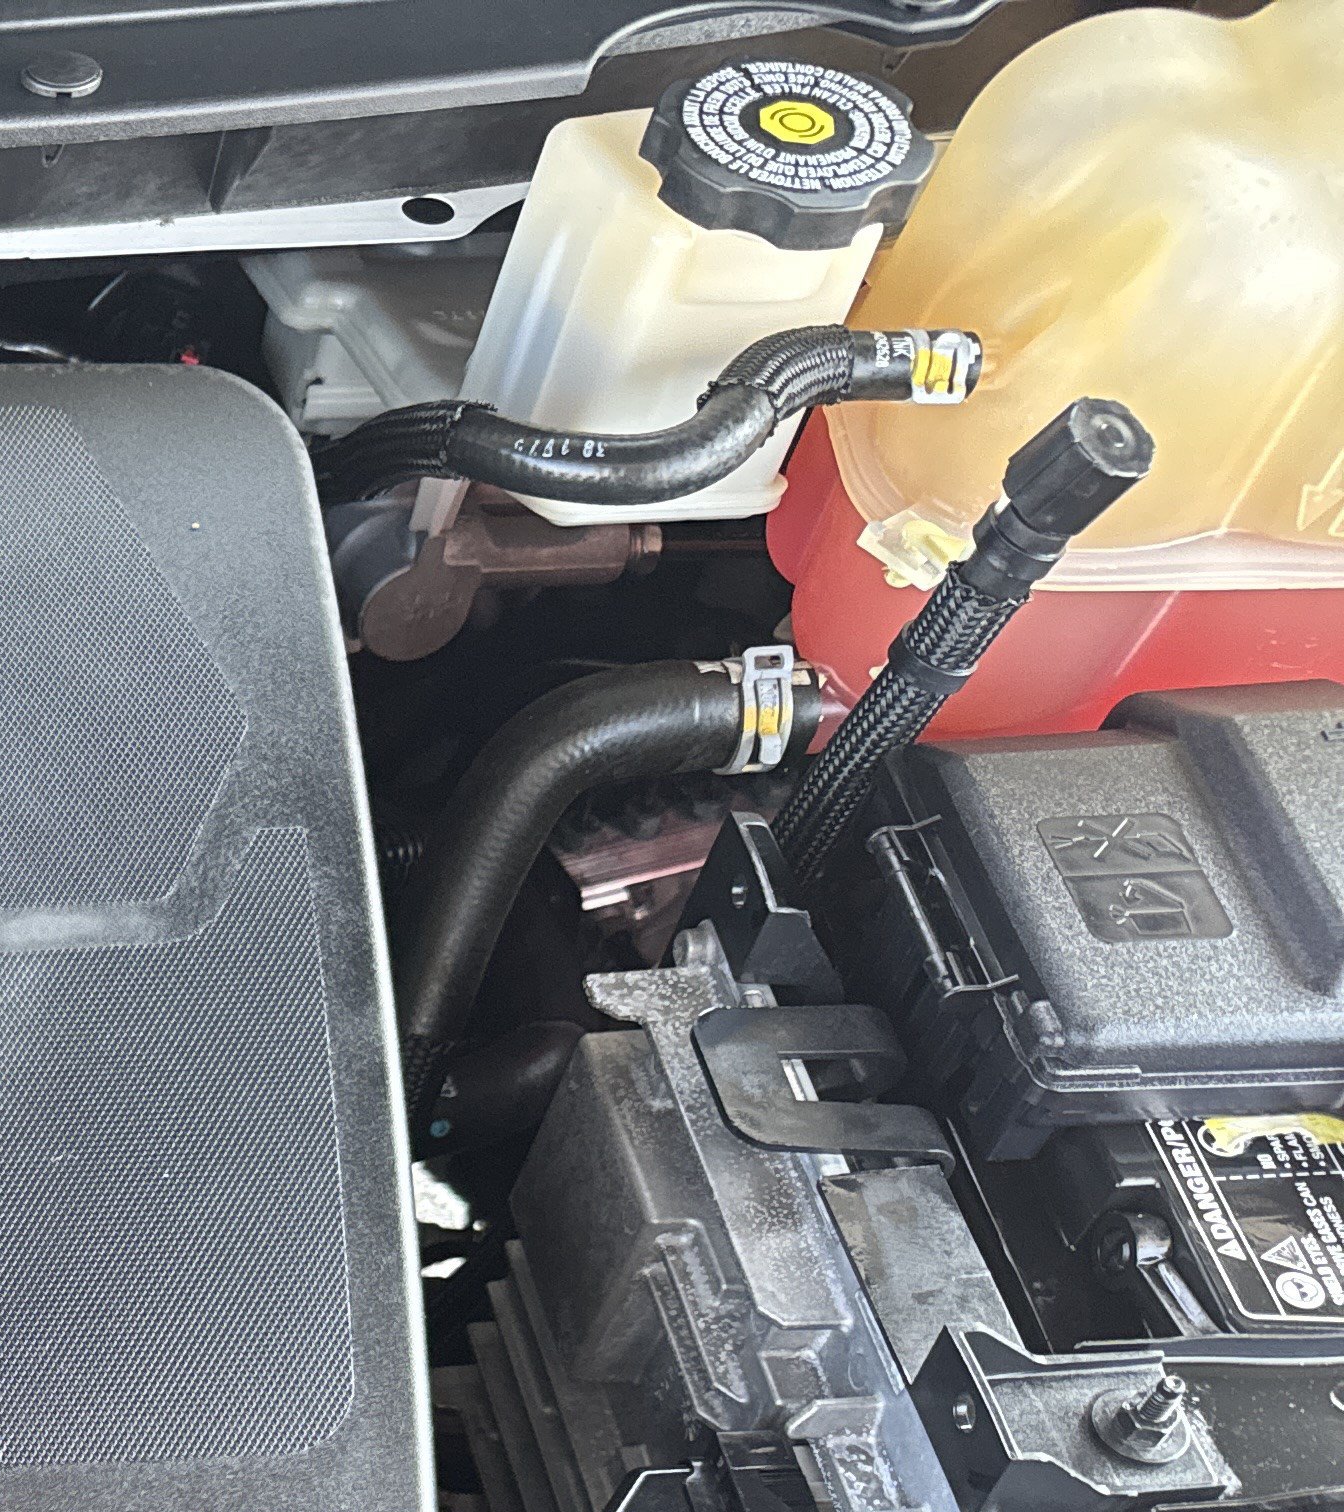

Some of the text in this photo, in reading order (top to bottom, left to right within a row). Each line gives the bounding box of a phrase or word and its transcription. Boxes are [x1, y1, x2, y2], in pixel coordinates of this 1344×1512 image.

[746, 72, 786, 84] ONLY
[786, 72, 815, 85] USE
[685, 87, 708, 101] LA
[758, 82, 857, 111] CLEAN FILLER
[739, 152, 766, 167] DU
[775, 145, 860, 166] PROVENANT
[725, 159, 752, 174] LE
[763, 159, 795, 176] QUE
[744, 166, 822, 190] NETTOYER
[1295, 1181, 1317, 1208] CAN
